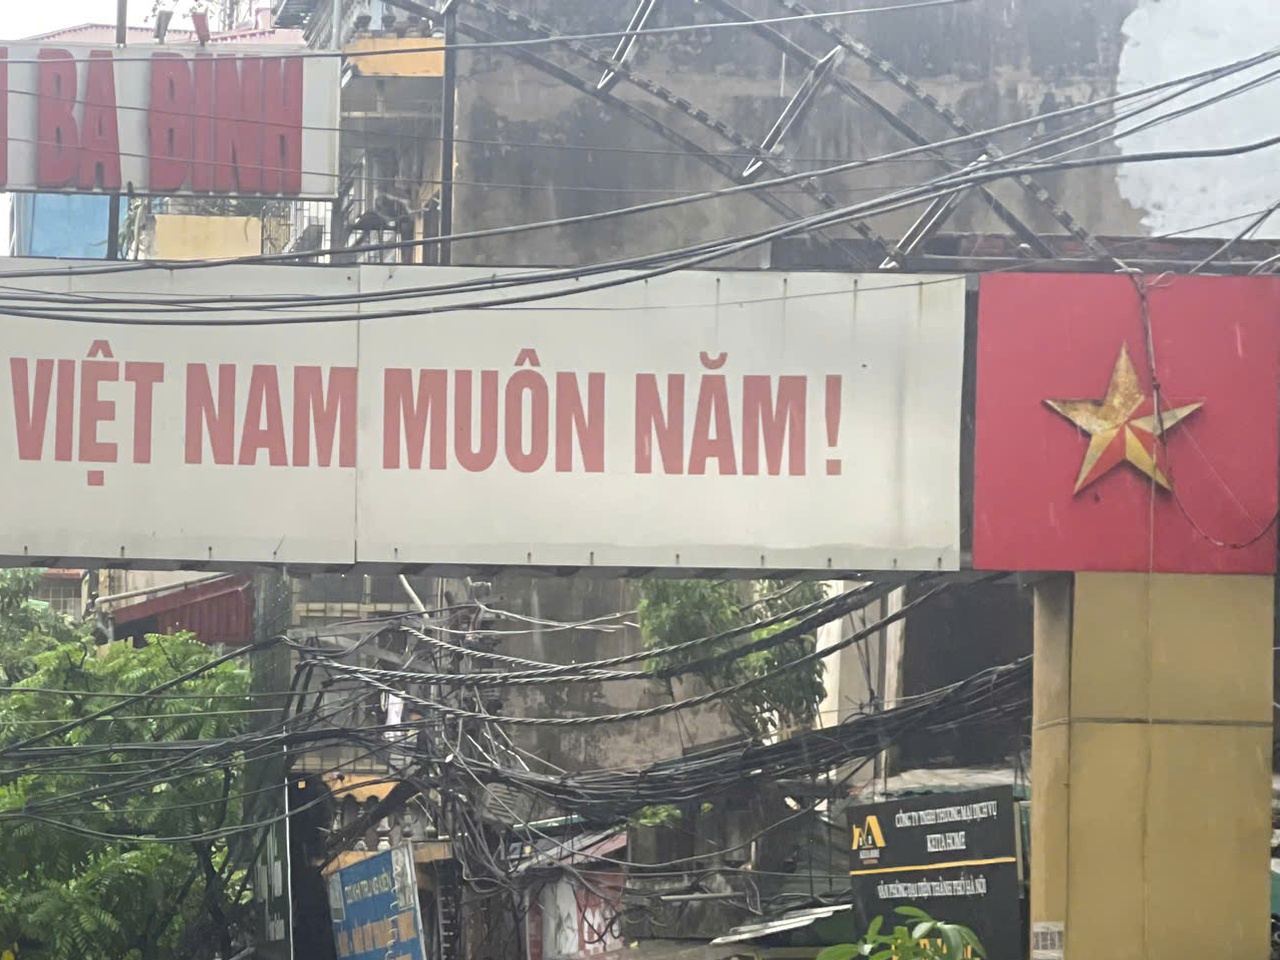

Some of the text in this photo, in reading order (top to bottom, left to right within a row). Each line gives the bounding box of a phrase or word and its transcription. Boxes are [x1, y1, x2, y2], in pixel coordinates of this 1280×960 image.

[35, 48, 122, 189] BA
[10, 340, 165, 487] VIỆT
[184, 362, 359, 469] NAM
[382, 348, 607, 474] MUÔN
